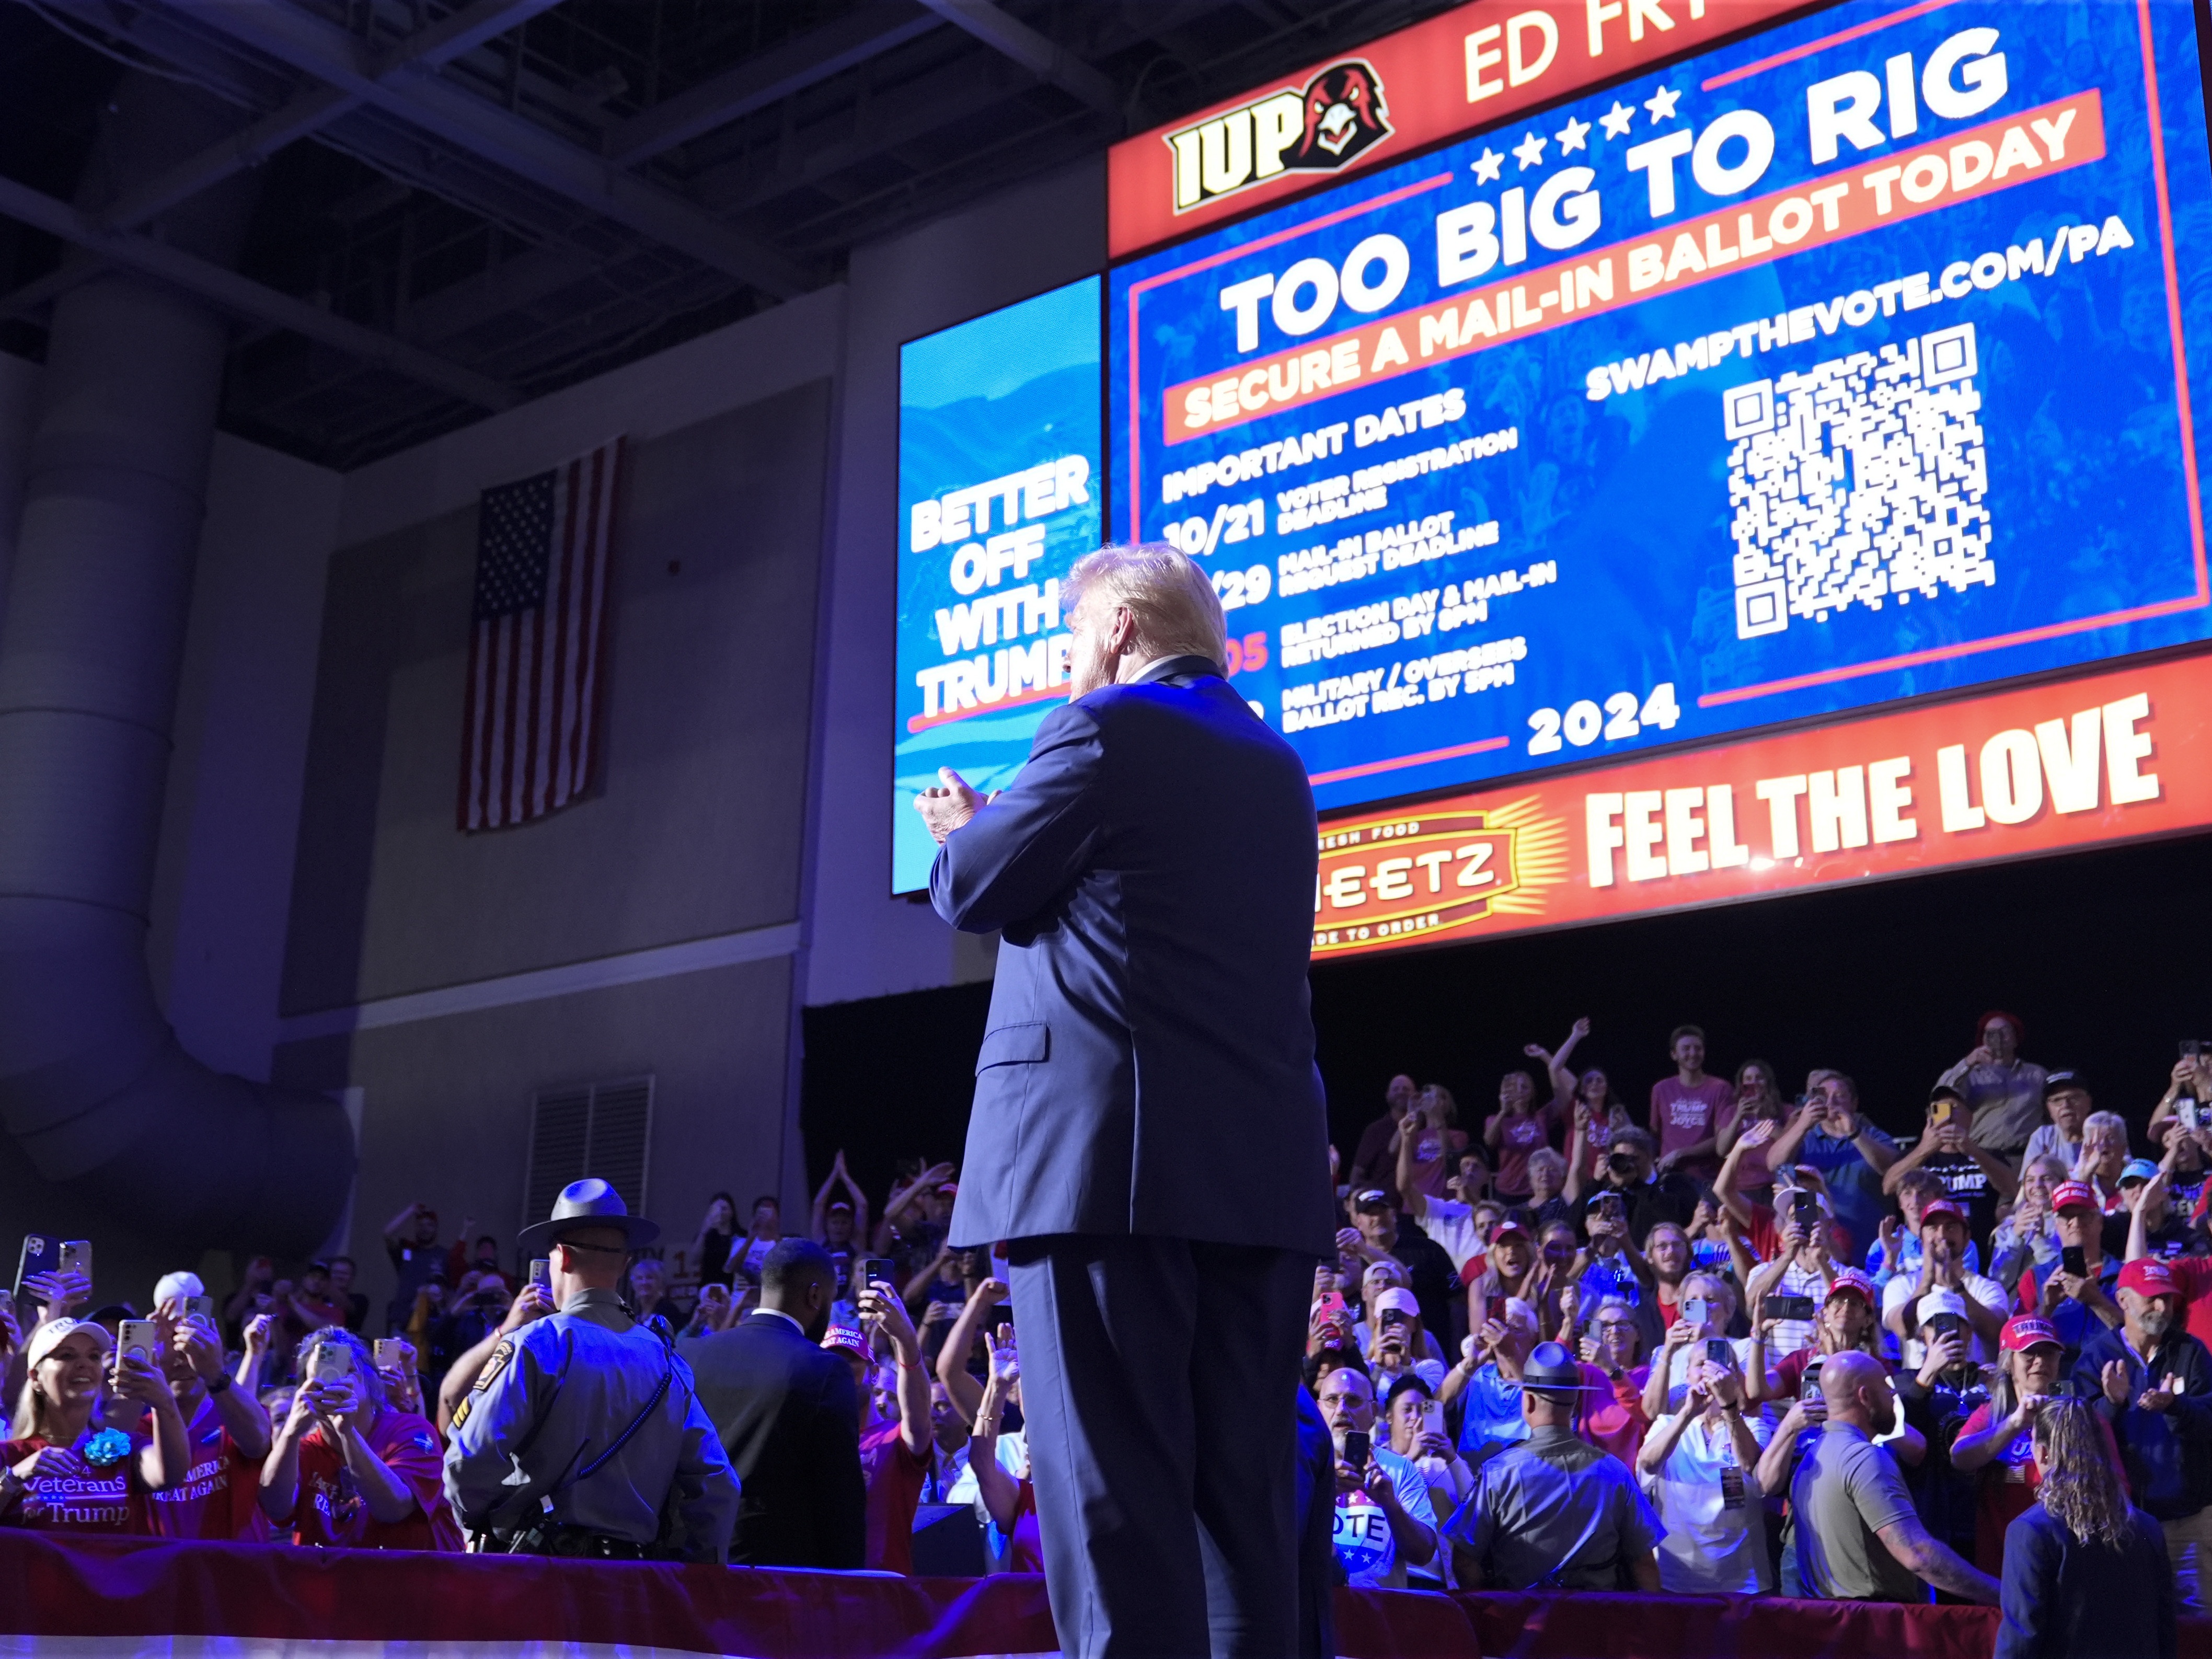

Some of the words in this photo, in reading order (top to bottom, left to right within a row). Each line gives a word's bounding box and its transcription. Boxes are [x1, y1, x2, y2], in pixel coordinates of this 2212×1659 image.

[1466, 10, 1559, 103] ED
[1586, 0, 1705, 57] FR
[1174, 93, 1304, 208] IUP
[1220, 233, 1410, 353] TOO
[1436, 166, 1601, 287] BIG
[1626, 109, 1775, 219] TO
[1807, 26, 2009, 165] RIG
[1184, 339, 1361, 428] SECURE
[1370, 327, 1409, 372] A
[1419, 258, 1613, 356] MAIL-IN
[1628, 182, 1849, 293] BALLOT
[1862, 108, 2078, 215] TODAY
[1585, 215, 2135, 402] SWAMPTHEVOTE.COM/PA
[1162, 421, 1349, 504] IMPORTANT
[1354, 387, 1467, 448] DATES
[1276, 475, 1351, 512] VOTER
[1352, 426, 1518, 492] REGISTRATION
[910, 454, 1090, 554] BETTER
[1162, 498, 1265, 556] 10/21
[1277, 485, 1388, 536] DEADLINE
[950, 524, 1045, 596] OFF
[1278, 535, 1363, 575] MAIL-IN
[1364, 510, 1455, 554] BALLOT
[1278, 552, 1380, 598] REQUEST
[1382, 520, 1500, 571] DEADLINE
[935, 578, 1059, 655] WITH
[1281, 601, 1389, 647] ELECTION
[1392, 589, 1440, 620] DAY
[1443, 584, 1461, 607] &
[1463, 560, 1557, 602] MAIL-IN
[1281, 621, 1400, 667] RETURNED
[1403, 612, 1435, 640] BY
[916, 633, 1074, 719] TRUMP
[1281, 667, 1385, 711] MILITARY
[1282, 695, 1369, 733] BALLOT
[1427, 674, 1461, 701] BY
[1527, 683, 1680, 756] 2024
[1586, 784, 1749, 888] FEEL
[1756, 756, 1917, 859] THE
[1937, 693, 2160, 833] LOVE
[1318, 831, 1361, 850] RESH
[1372, 821, 1420, 840] FOOD
[1316, 843, 1494, 912] EETZ
[1346, 926, 1370, 941] TO
[1377, 913, 1439, 937] ORDER
[46, 1502, 131, 1526] Trump
[1333, 1513, 1385, 1542] OTE
